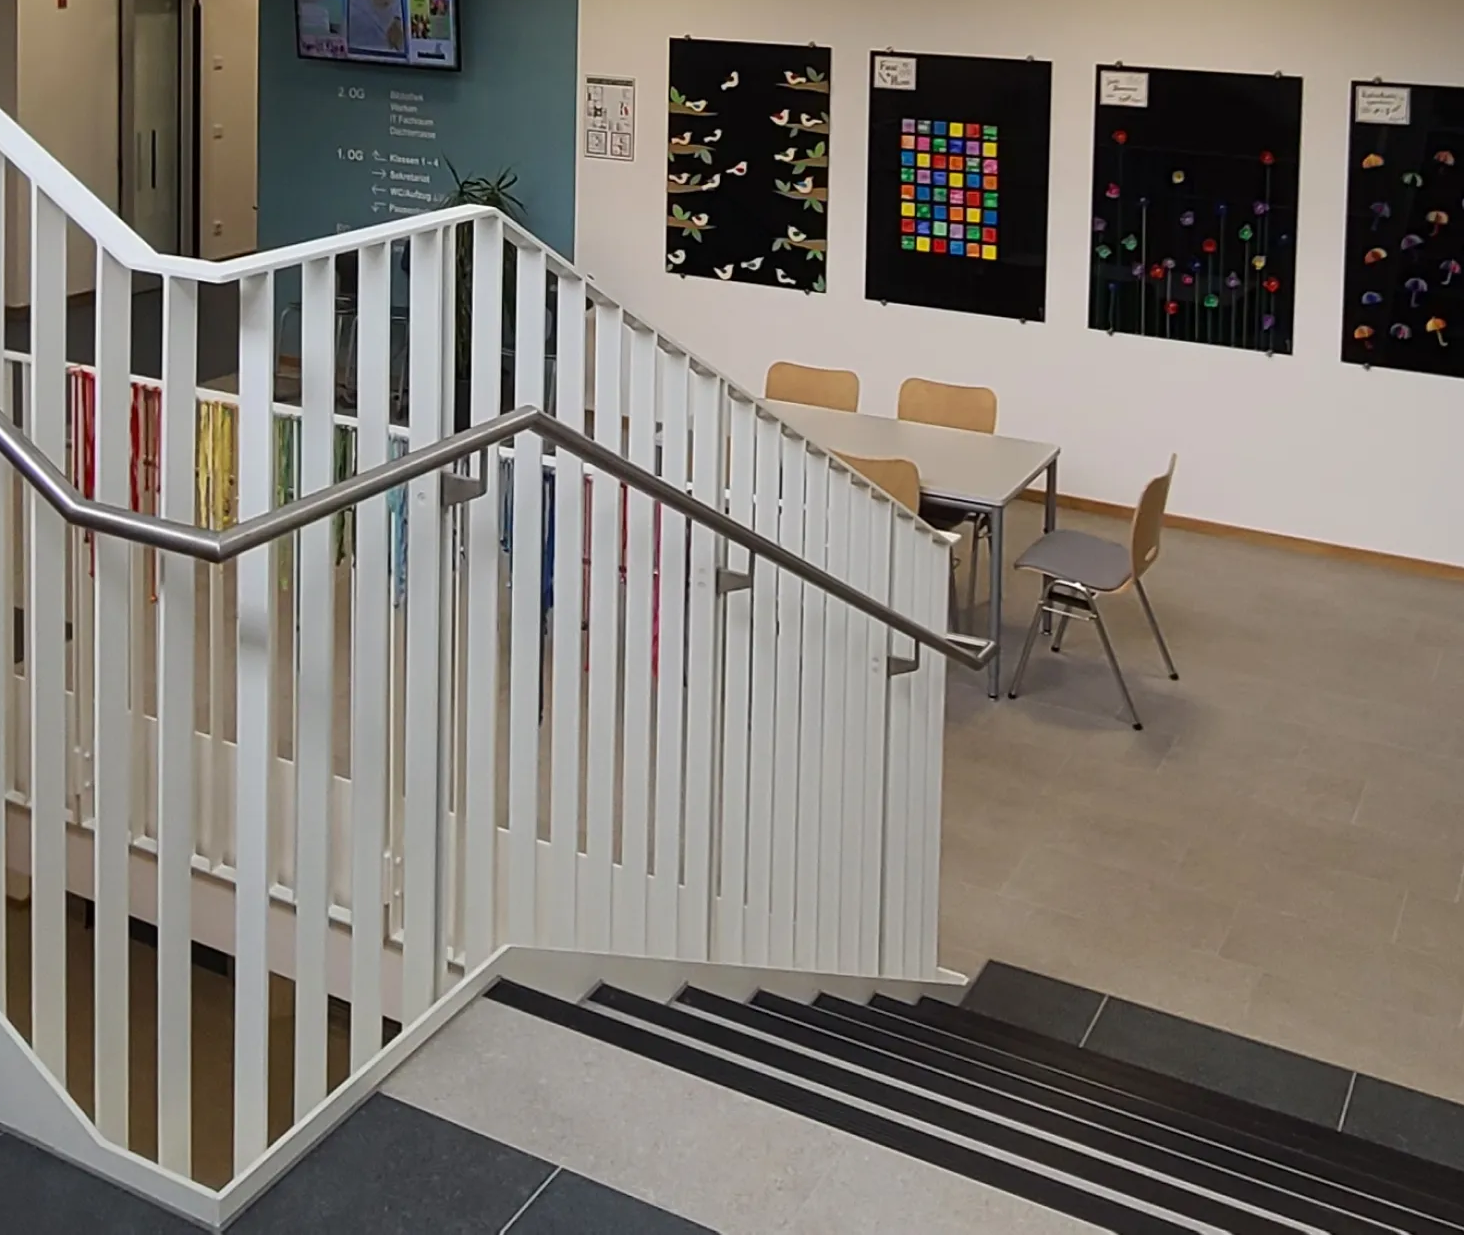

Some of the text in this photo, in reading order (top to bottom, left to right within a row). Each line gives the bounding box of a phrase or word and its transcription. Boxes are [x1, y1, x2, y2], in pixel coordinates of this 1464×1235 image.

[348, 86, 365, 99] OG
[347, 149, 364, 161] OG
[389, 154, 419, 165] Klassen
